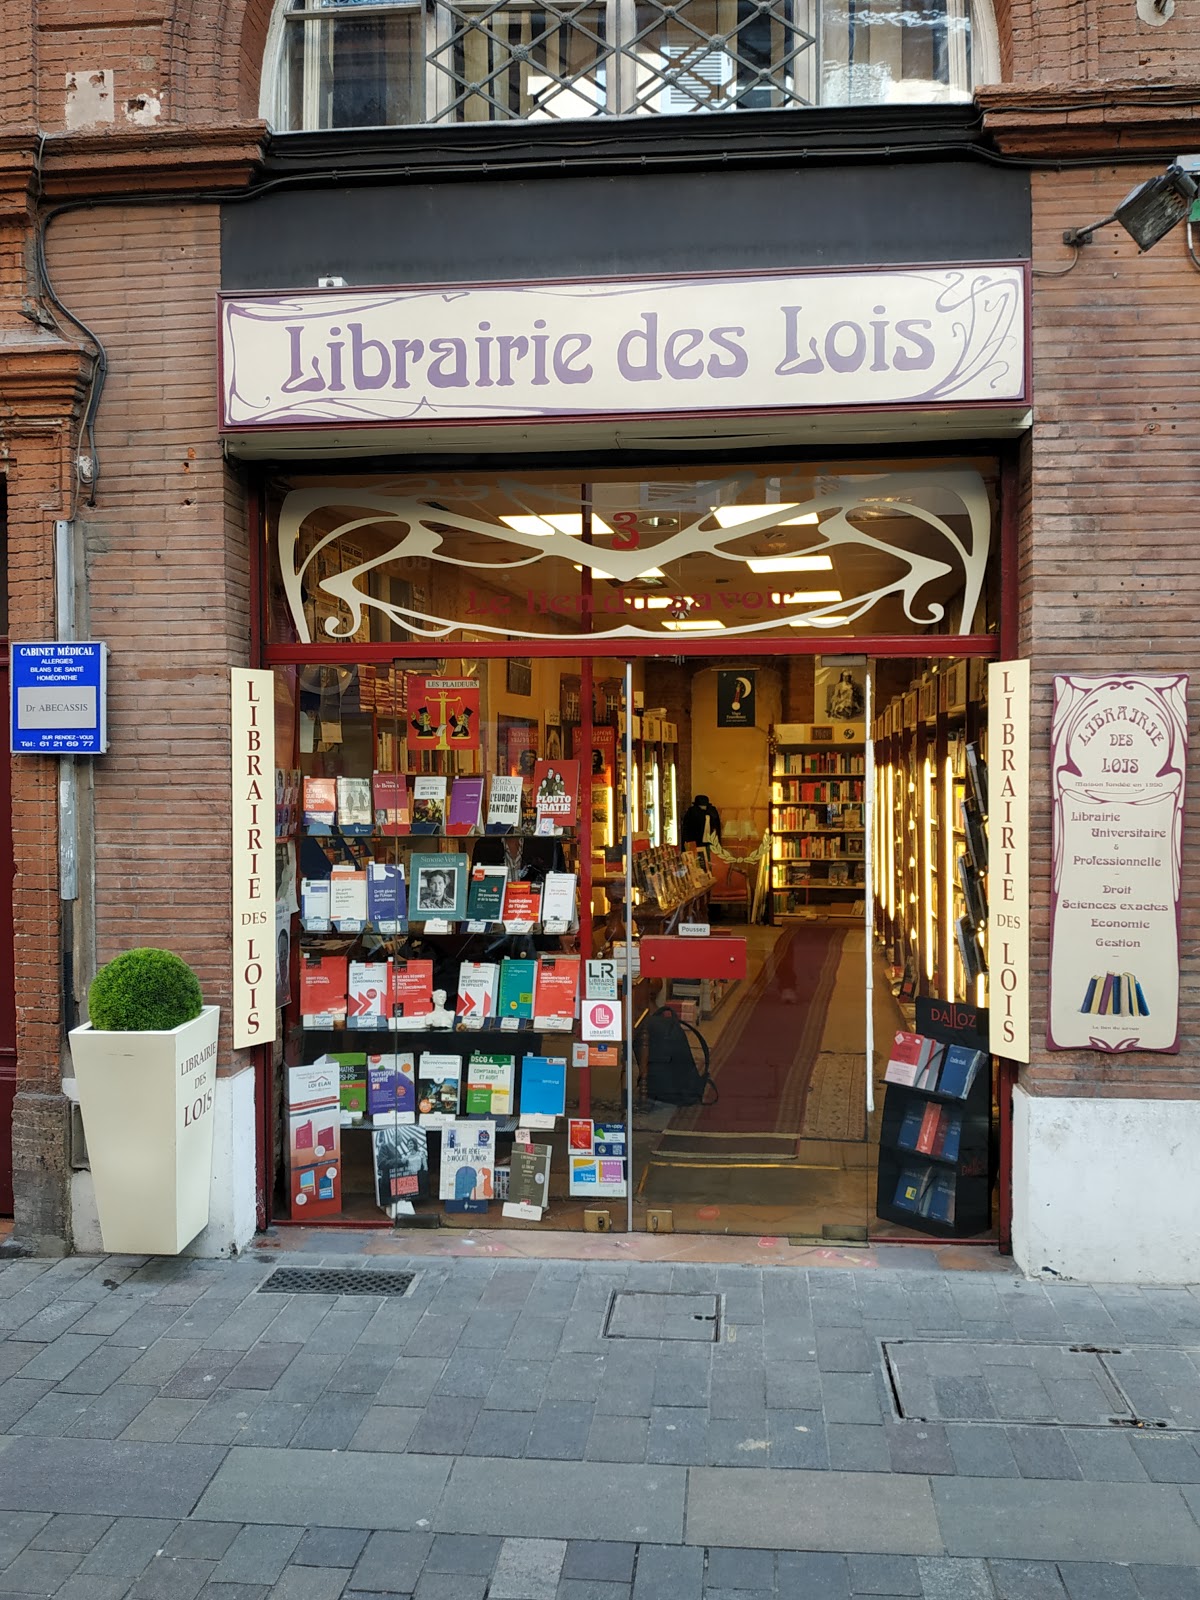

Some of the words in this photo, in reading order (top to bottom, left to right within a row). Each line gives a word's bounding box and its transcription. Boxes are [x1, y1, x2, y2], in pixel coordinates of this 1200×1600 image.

[281, 319, 593, 393] Librairie
[617, 311, 749, 381] des
[774, 304, 936, 376] Lois
[611, 511, 640, 550] 3
[465, 590, 511, 615] Le
[20, 647, 55, 657] CABINET
[57, 645, 95, 656] MÉDICAL
[64, 665, 85, 673] SANTÉ
[26, 704, 36, 712] Dr
[38, 703, 89, 712] ABECASSIS
[1077, 705, 1165, 747] LIBRAIRIE
[1109, 733, 1134, 747] DES
[1101, 758, 1139, 774] LOIS
[246, 680, 263, 900] LIBRAIRIE
[1000, 671, 1017, 902] LIBRAIRIE
[536, 795, 571, 803] PLOUTO
[489, 803, 518, 813] FANTÔME
[1071, 812, 1121, 822] Librairie
[1091, 828, 1166, 838] Universitaire
[1073, 855, 1162, 867] Professionnelle
[1102, 885, 1132, 894] Droit
[1062, 899, 1117, 910] Sciences
[1119, 901, 1169, 912] exactes
[241, 911, 267, 926] DES
[996, 914, 1021, 930] DES
[1095, 937, 1141, 948] Gestion
[244, 938, 263, 1035] LOIS
[1000, 943, 1018, 1043] LOIS
[181, 1041, 216, 1076] LIBRAIRIE
[194, 1072, 207, 1089] DES
[184, 1088, 213, 1127] LOIS
